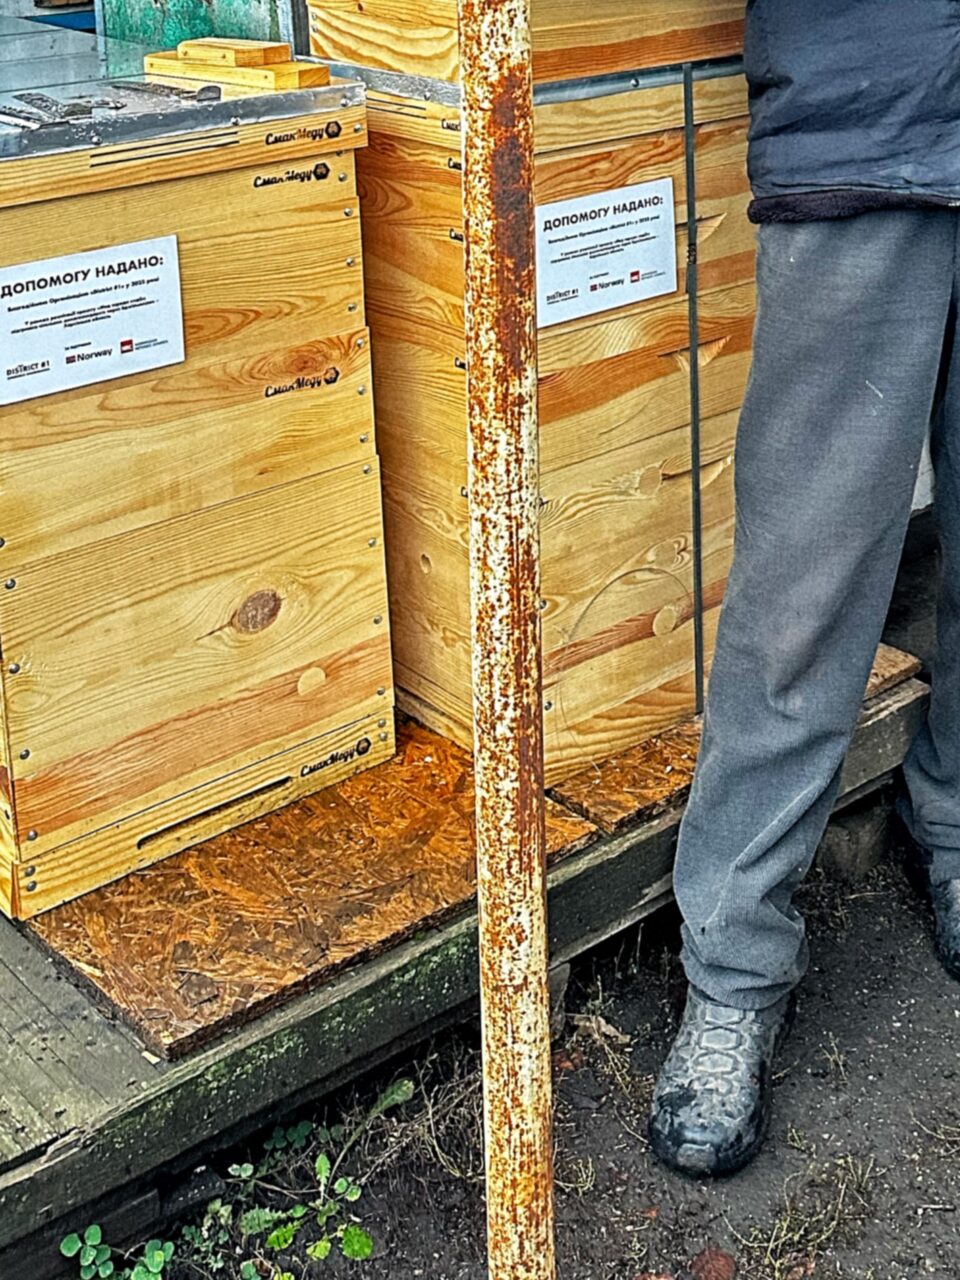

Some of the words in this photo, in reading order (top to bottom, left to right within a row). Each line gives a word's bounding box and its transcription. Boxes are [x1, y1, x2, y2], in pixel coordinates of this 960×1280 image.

[265, 128, 324, 146] СмакМеду
[543, 206, 610, 232] ДОПОМОГУ
[613, 195, 663, 215] НАДАНО:
[1, 269, 91, 298] ДОПОМОГУ
[95, 256, 164, 278] НАДАНО:
[598, 278, 625, 289] Norway
[77, 348, 113, 362] Norway
